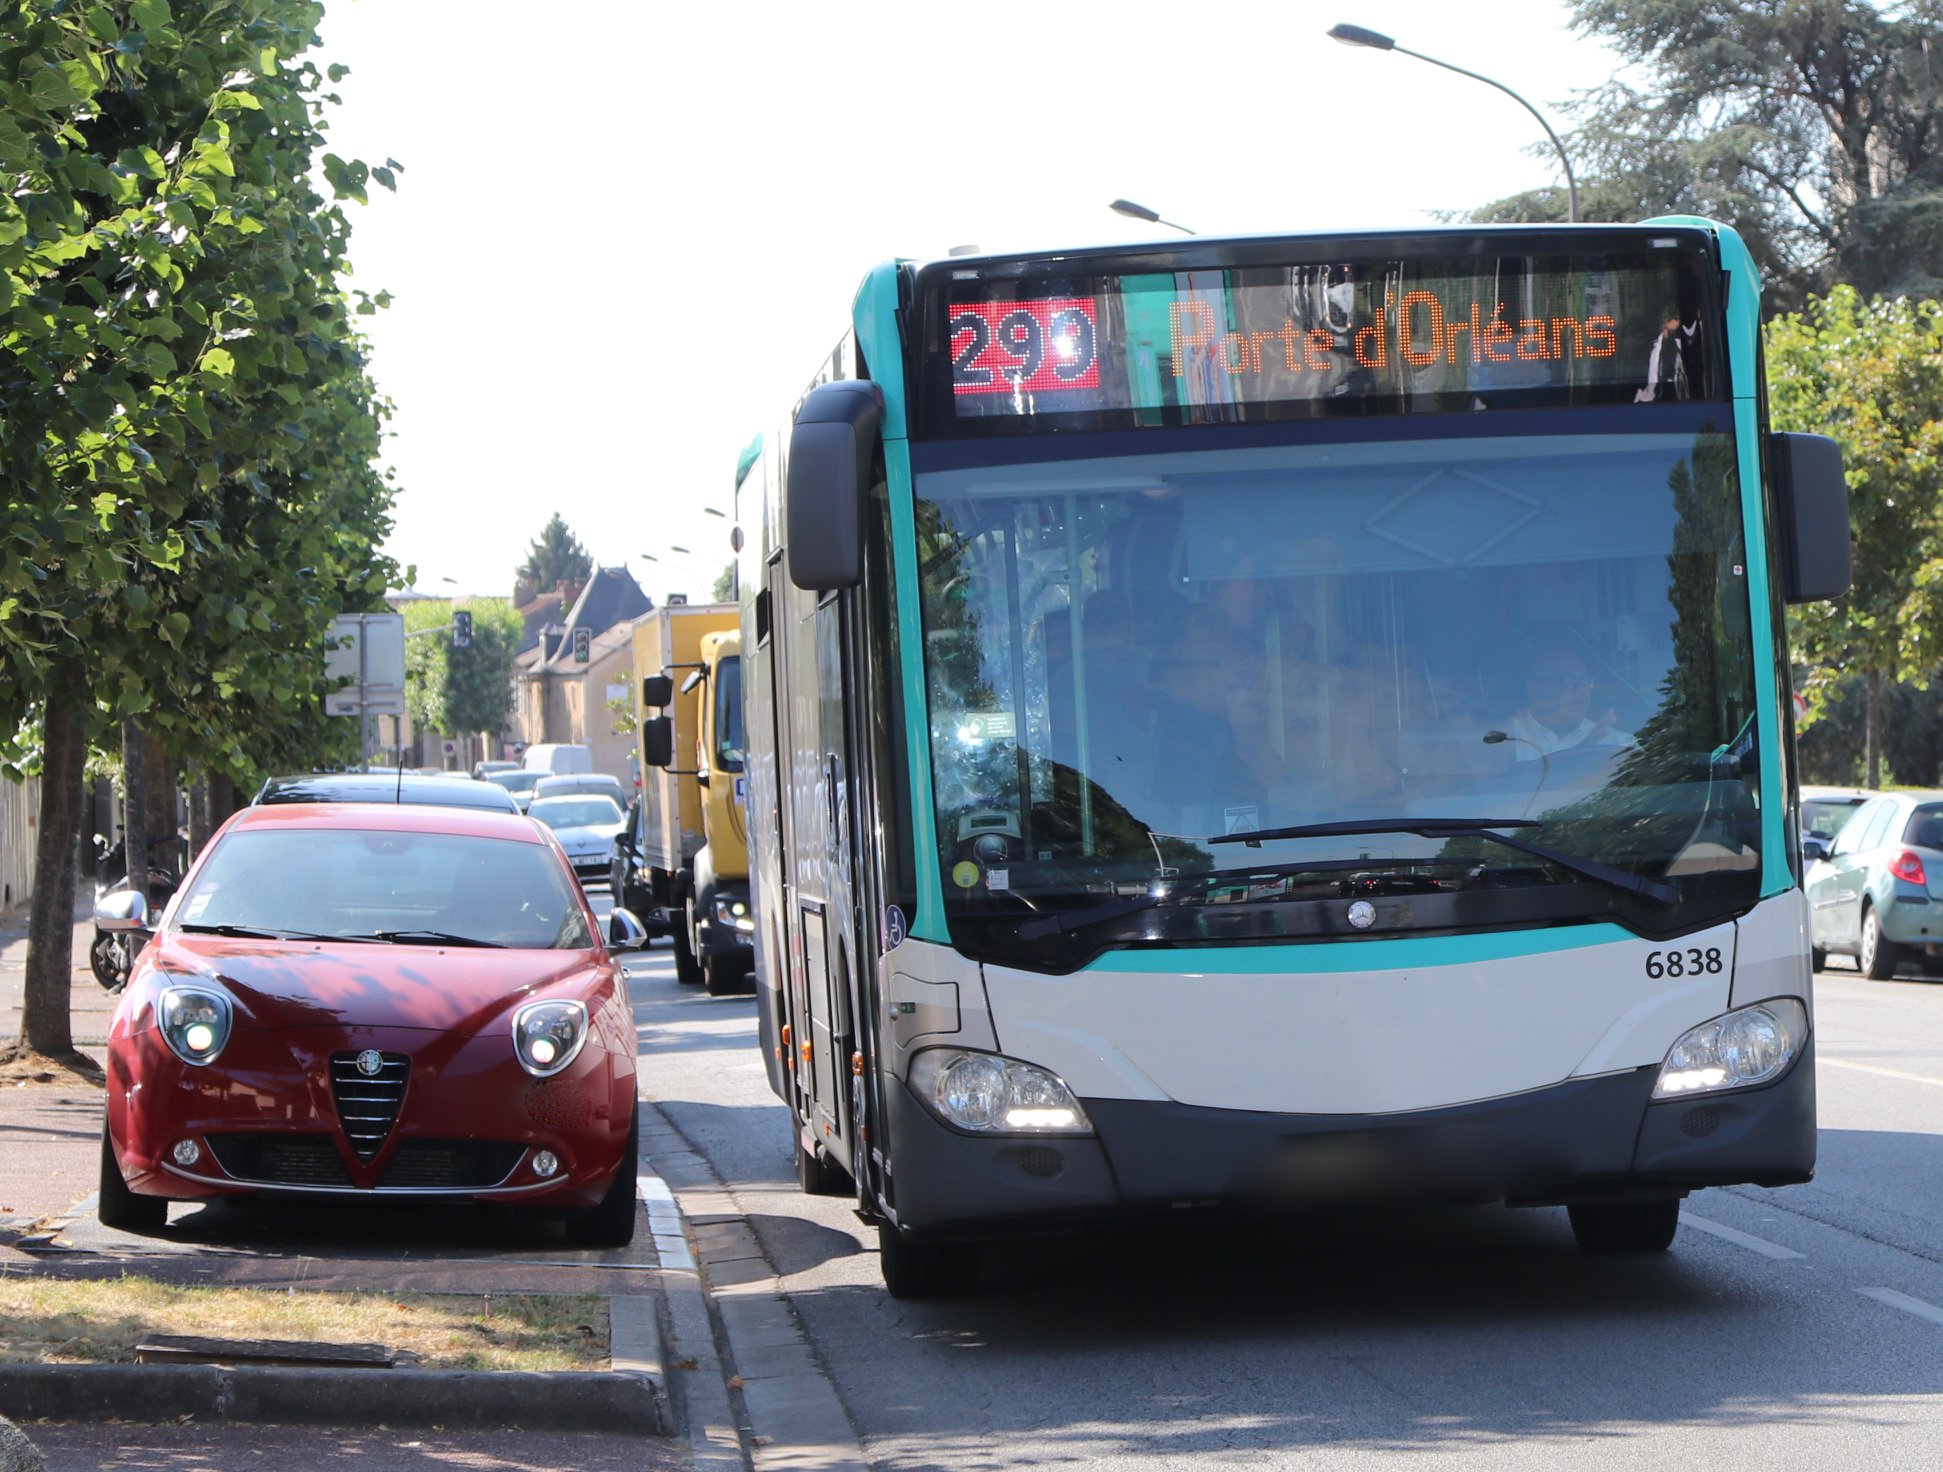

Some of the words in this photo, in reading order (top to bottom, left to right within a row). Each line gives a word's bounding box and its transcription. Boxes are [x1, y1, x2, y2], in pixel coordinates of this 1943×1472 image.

[950, 310, 1097, 386] 299
[1169, 301, 1334, 377] Porte
[1354, 290, 1616, 368] d'Orléans
[1645, 947, 1723, 979] 6838
